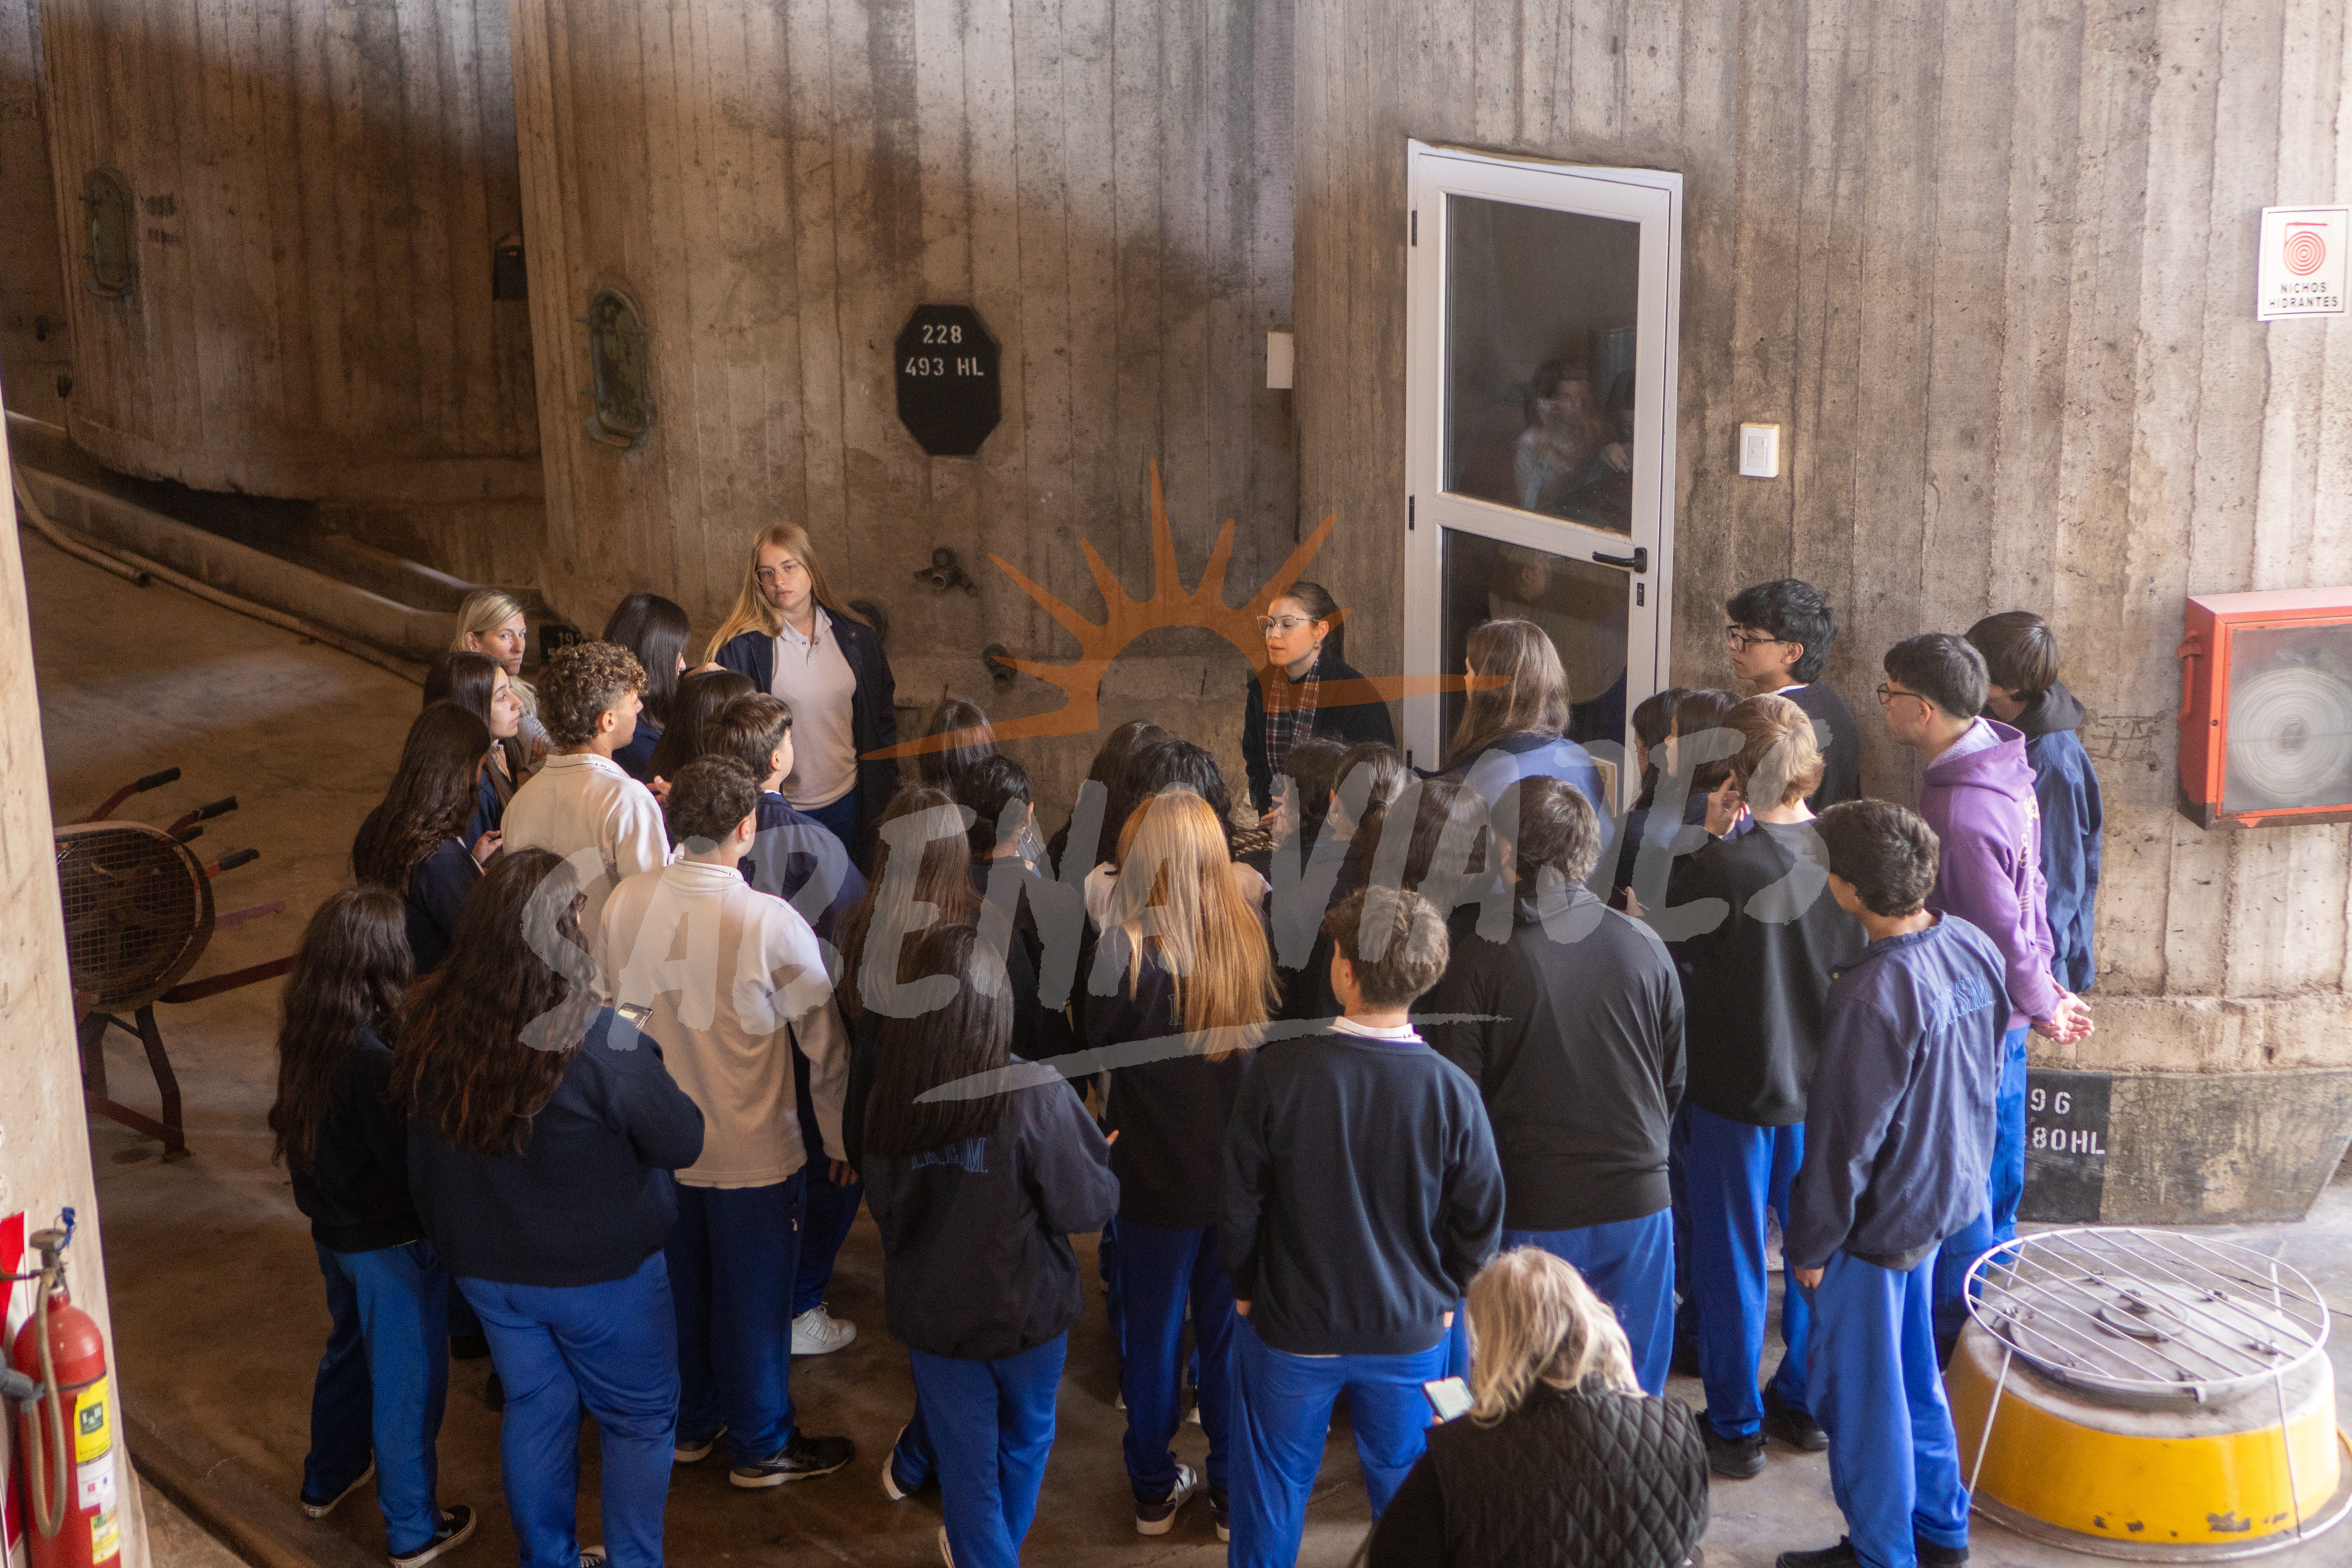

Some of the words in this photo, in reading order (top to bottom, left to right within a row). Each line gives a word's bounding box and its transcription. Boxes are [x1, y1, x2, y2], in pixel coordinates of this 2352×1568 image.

[2280, 282, 2328, 294] NICHOS
[2269, 296, 2339, 309] HIDRANTES
[922, 324, 963, 345] 228
[905, 356, 945, 377] 493
[956, 356, 985, 377] HL
